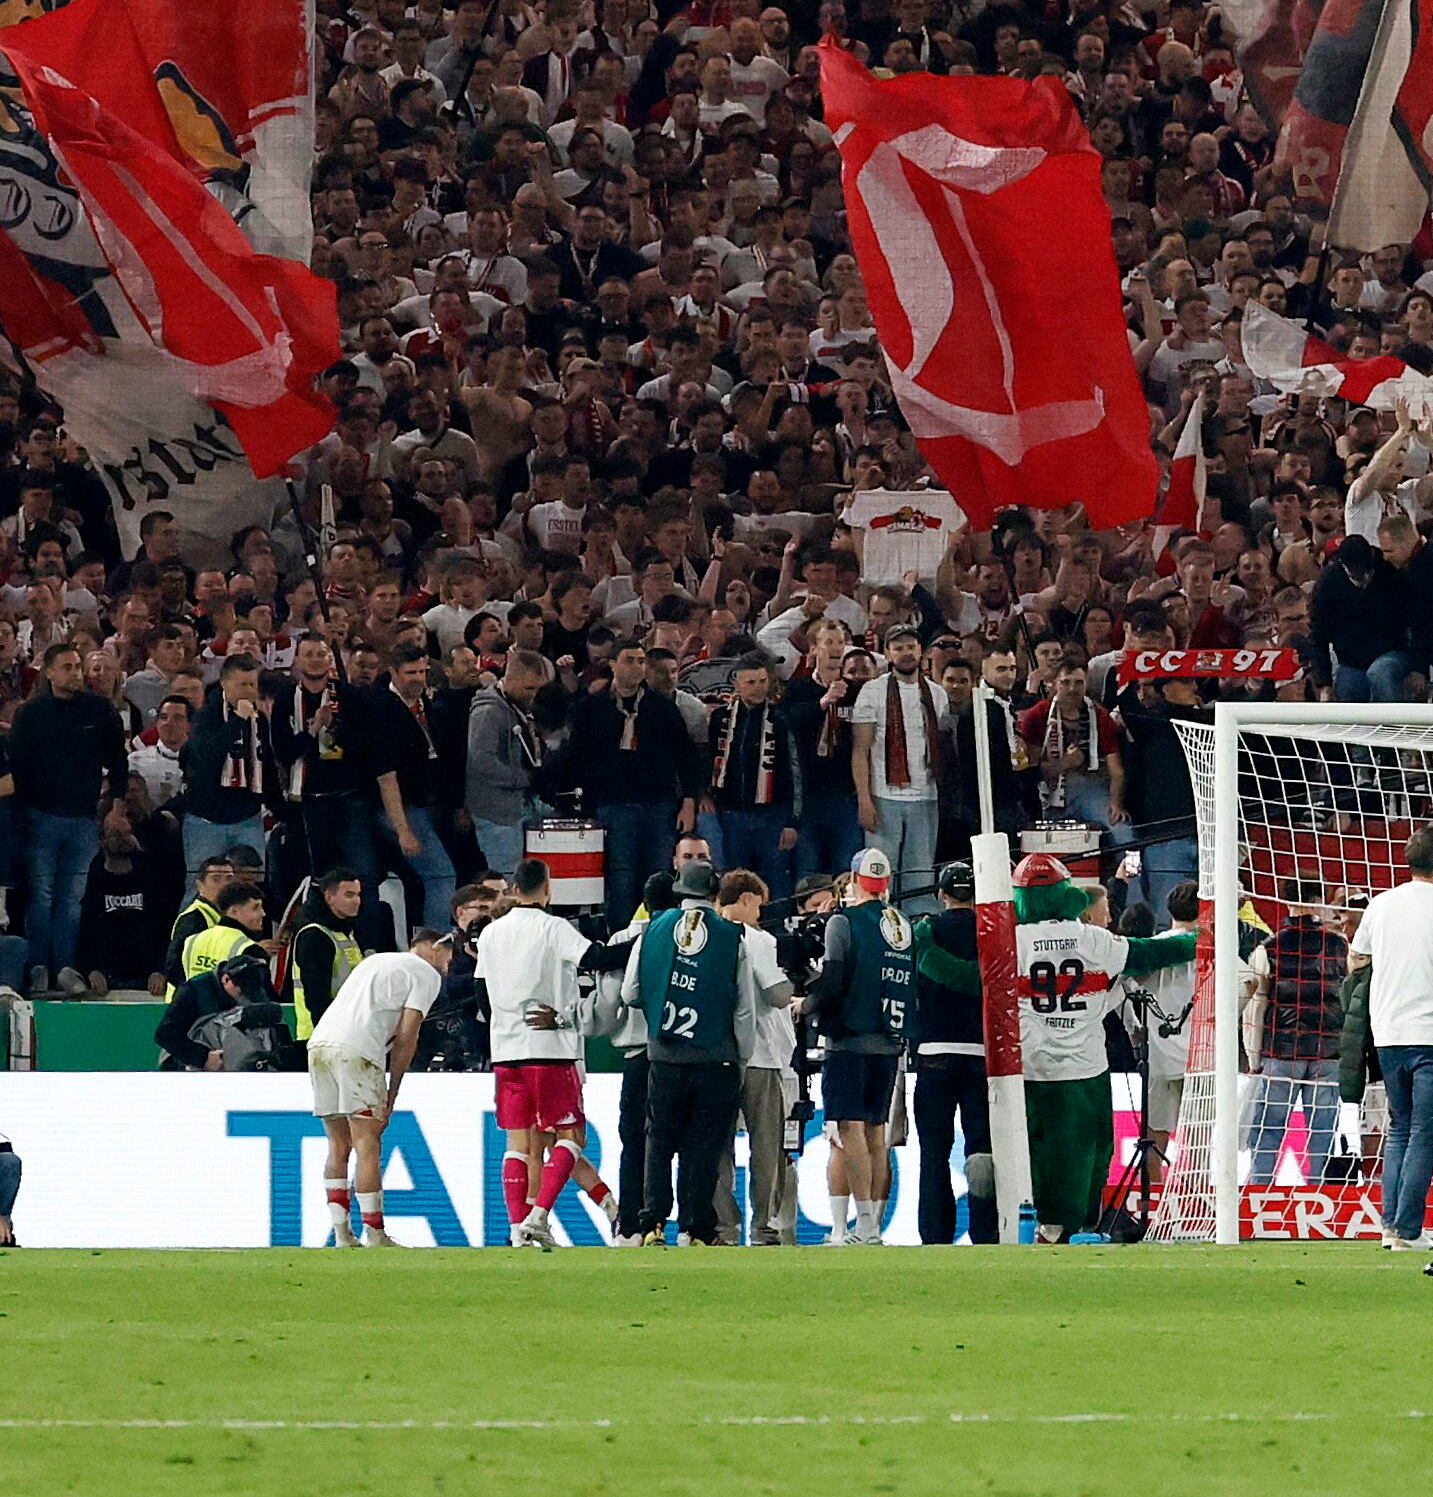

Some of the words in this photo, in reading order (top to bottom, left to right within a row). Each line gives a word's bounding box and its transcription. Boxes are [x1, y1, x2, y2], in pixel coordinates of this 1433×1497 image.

[1134, 651, 1184, 673] CC
[1231, 650, 1282, 672] 97
[1029, 958, 1088, 1014] 92
